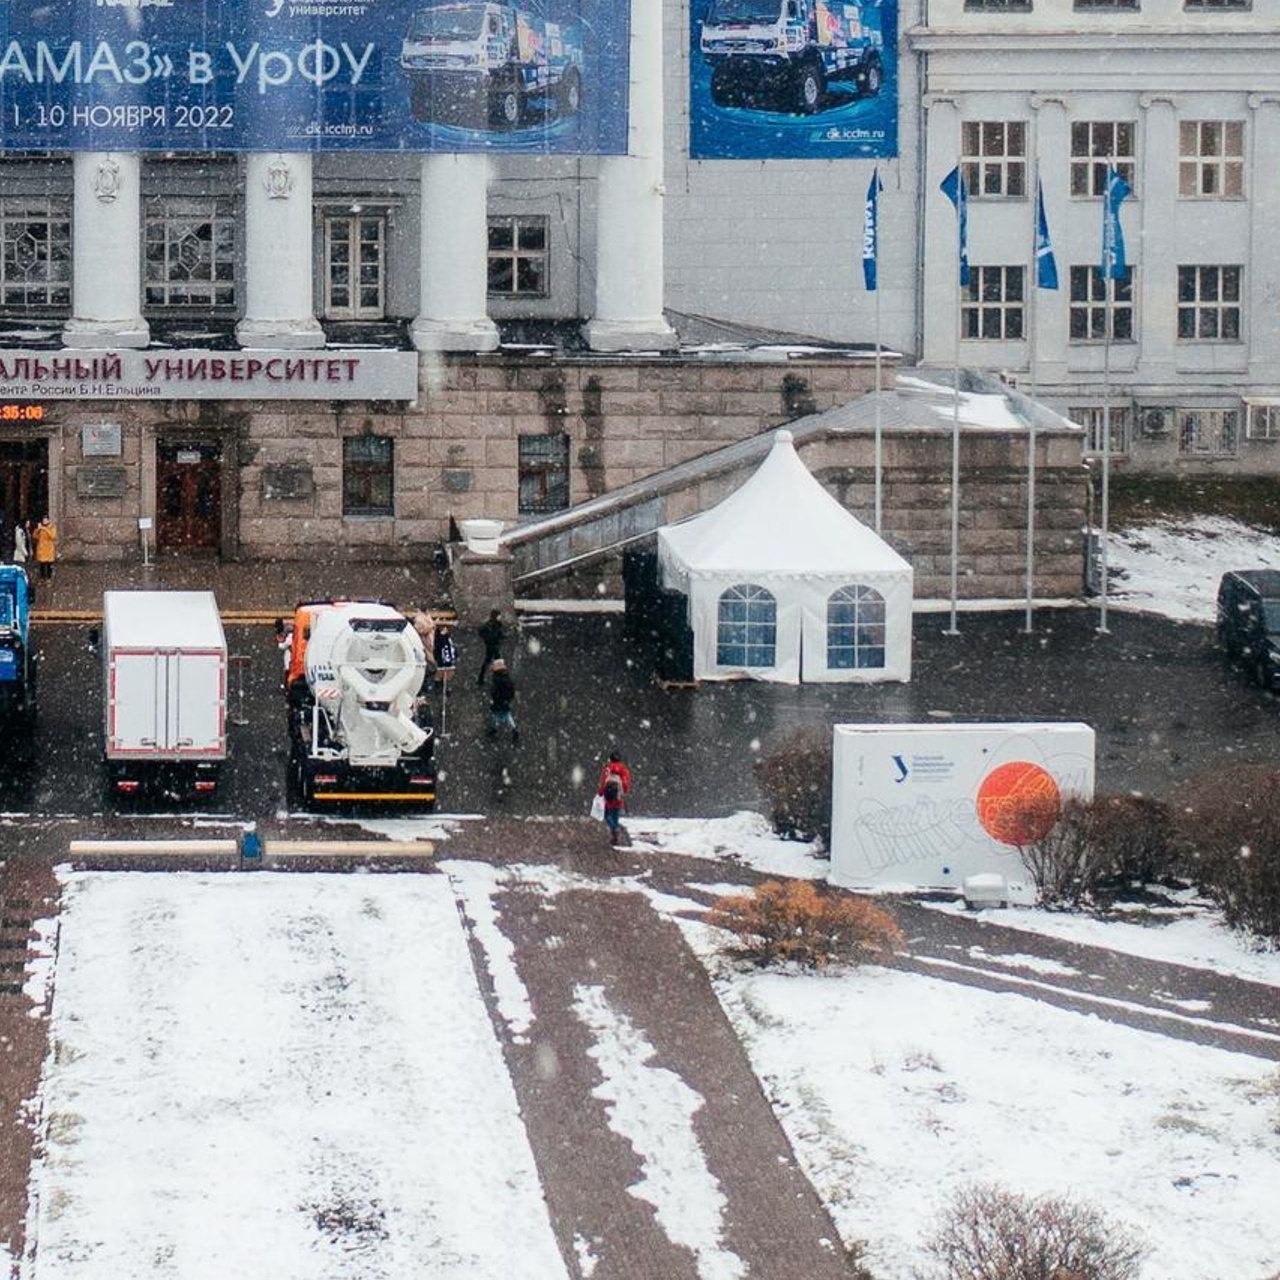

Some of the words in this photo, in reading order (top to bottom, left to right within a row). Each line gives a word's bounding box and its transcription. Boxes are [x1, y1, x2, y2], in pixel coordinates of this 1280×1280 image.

[288, 4, 368, 17] университет
[189, 51, 214, 85] в
[225, 38, 376, 95] УрФУ
[36, 104, 66, 127] 10
[72, 105, 166, 128] НОЯБРЯ
[174, 105, 235, 128] 2022
[144, 357, 361, 382] УНИВЕРСИТЕТ
[31, 383, 77, 395] России
